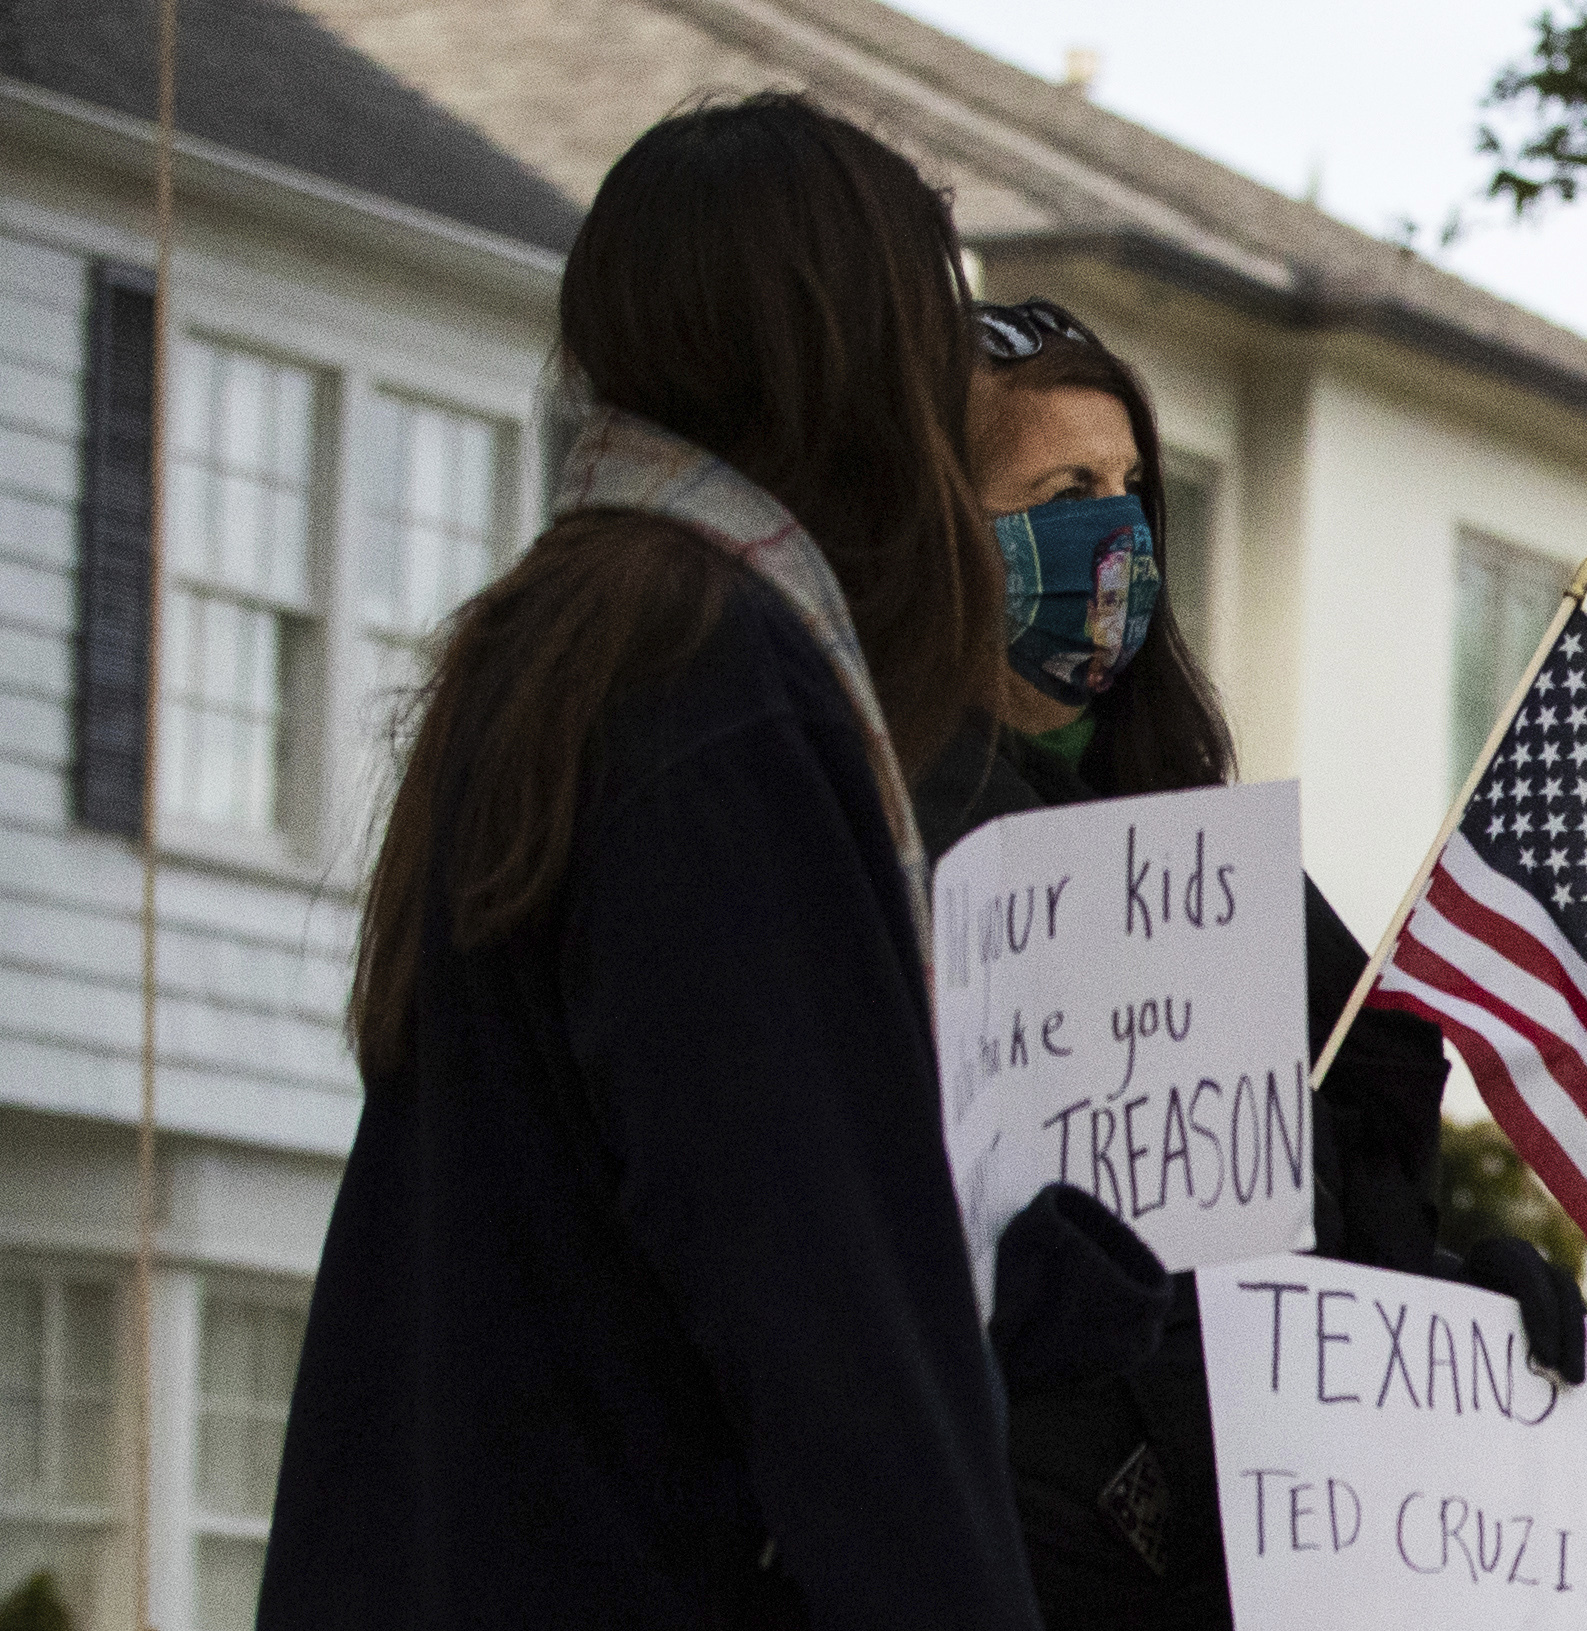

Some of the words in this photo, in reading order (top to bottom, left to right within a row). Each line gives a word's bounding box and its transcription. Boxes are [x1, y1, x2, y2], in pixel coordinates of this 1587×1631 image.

[1125, 825, 1236, 940] kids
[1110, 996, 1193, 1102] you
[1042, 1061, 1303, 1219] TREASON
[1239, 1468, 1363, 1557] TED
